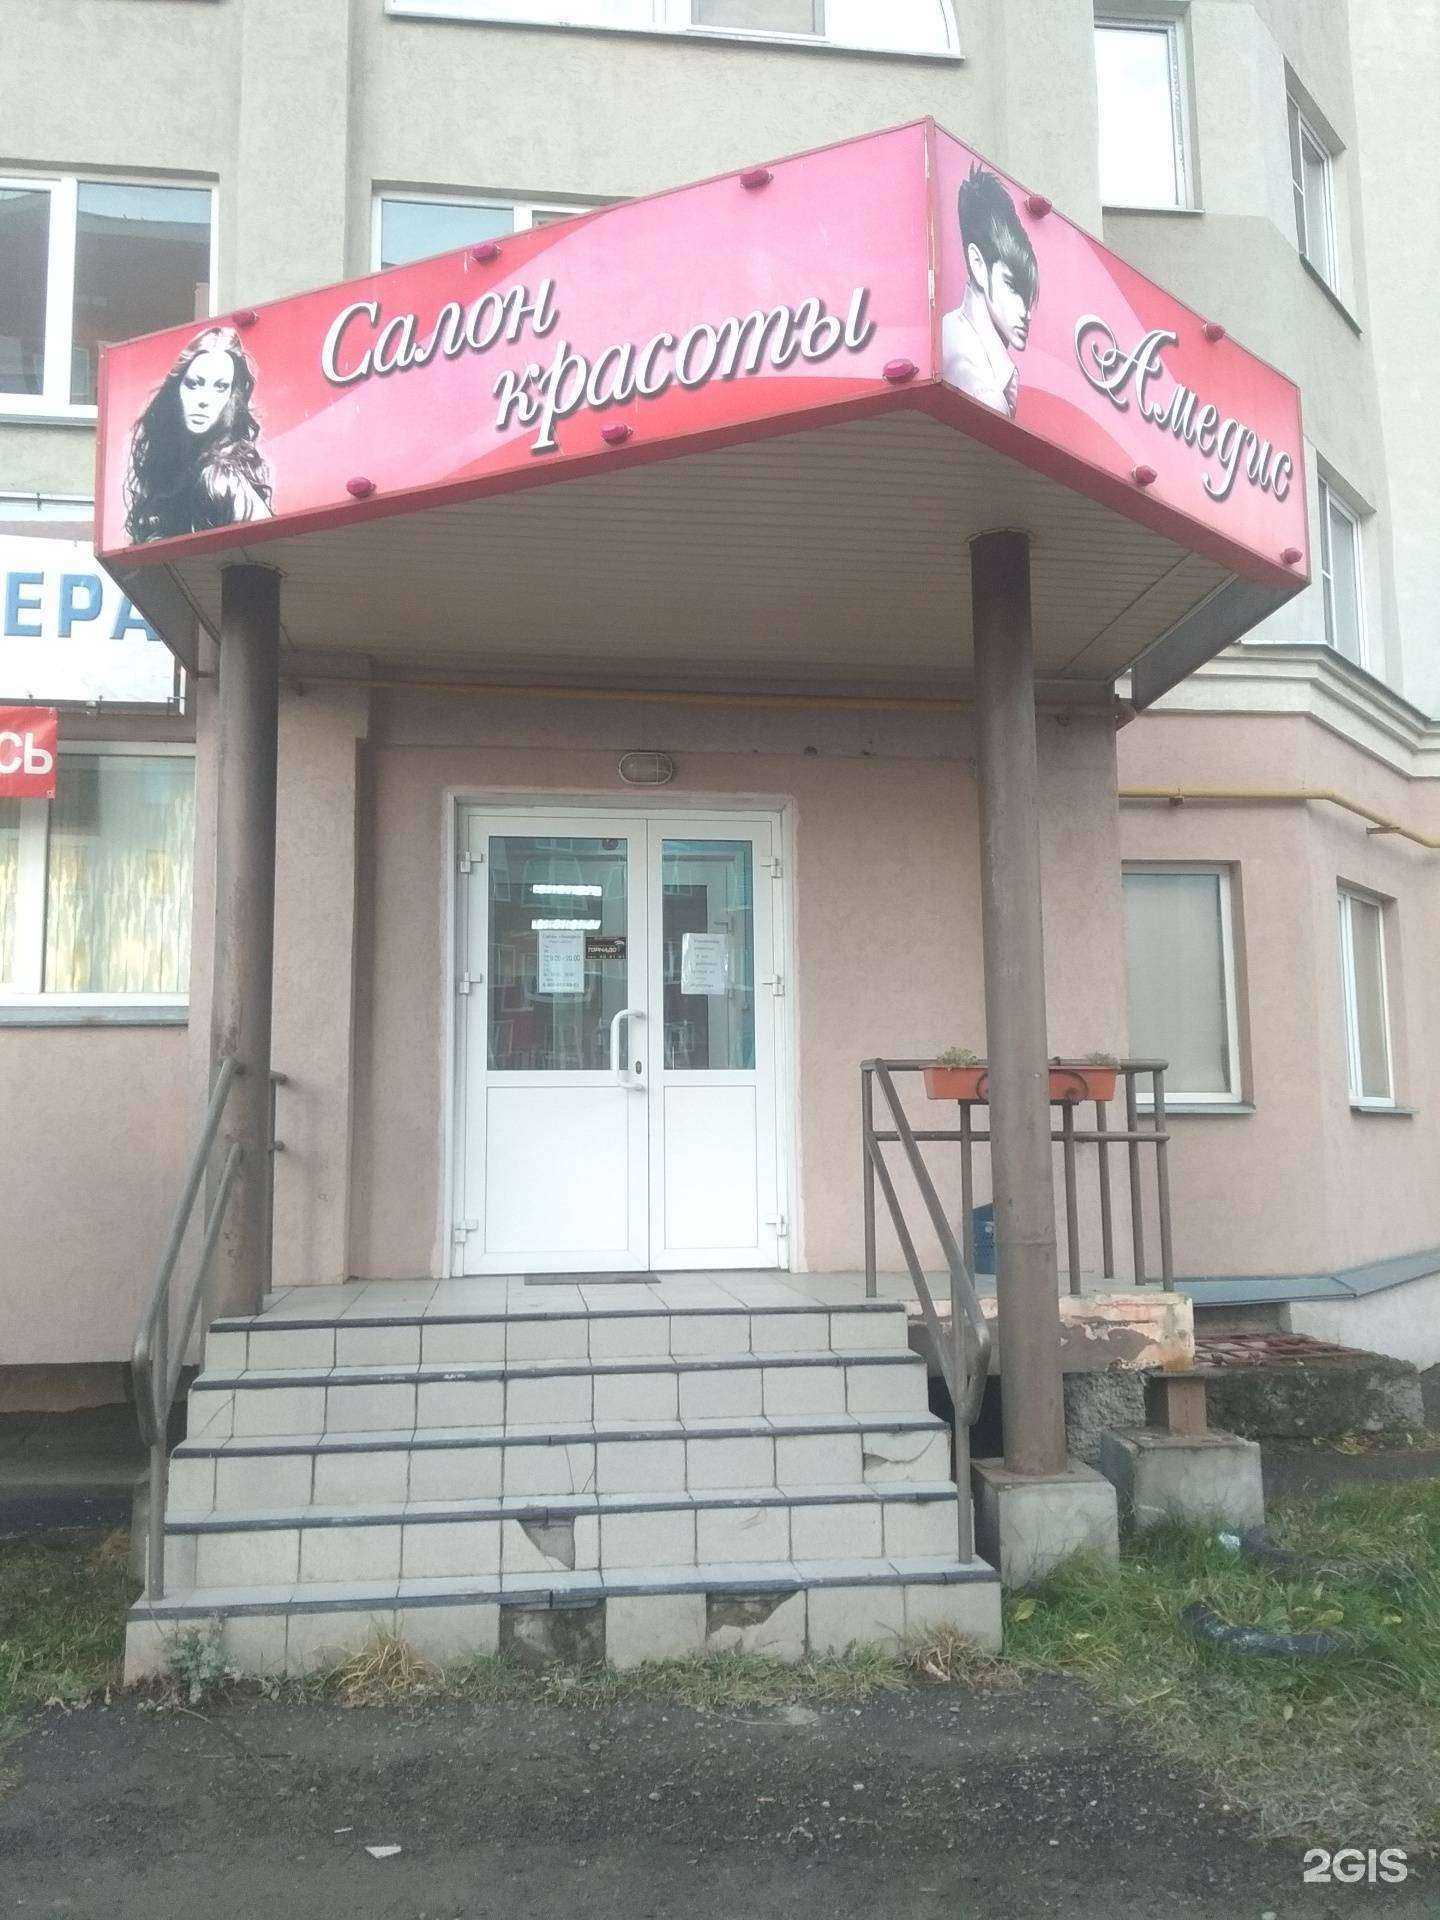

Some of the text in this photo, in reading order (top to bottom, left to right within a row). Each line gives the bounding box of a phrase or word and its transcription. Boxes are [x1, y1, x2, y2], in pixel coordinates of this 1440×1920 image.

[321, 278, 559, 385] Салон
[493, 286, 872, 452] красоты
[1074, 314, 1293, 499] Амедис
